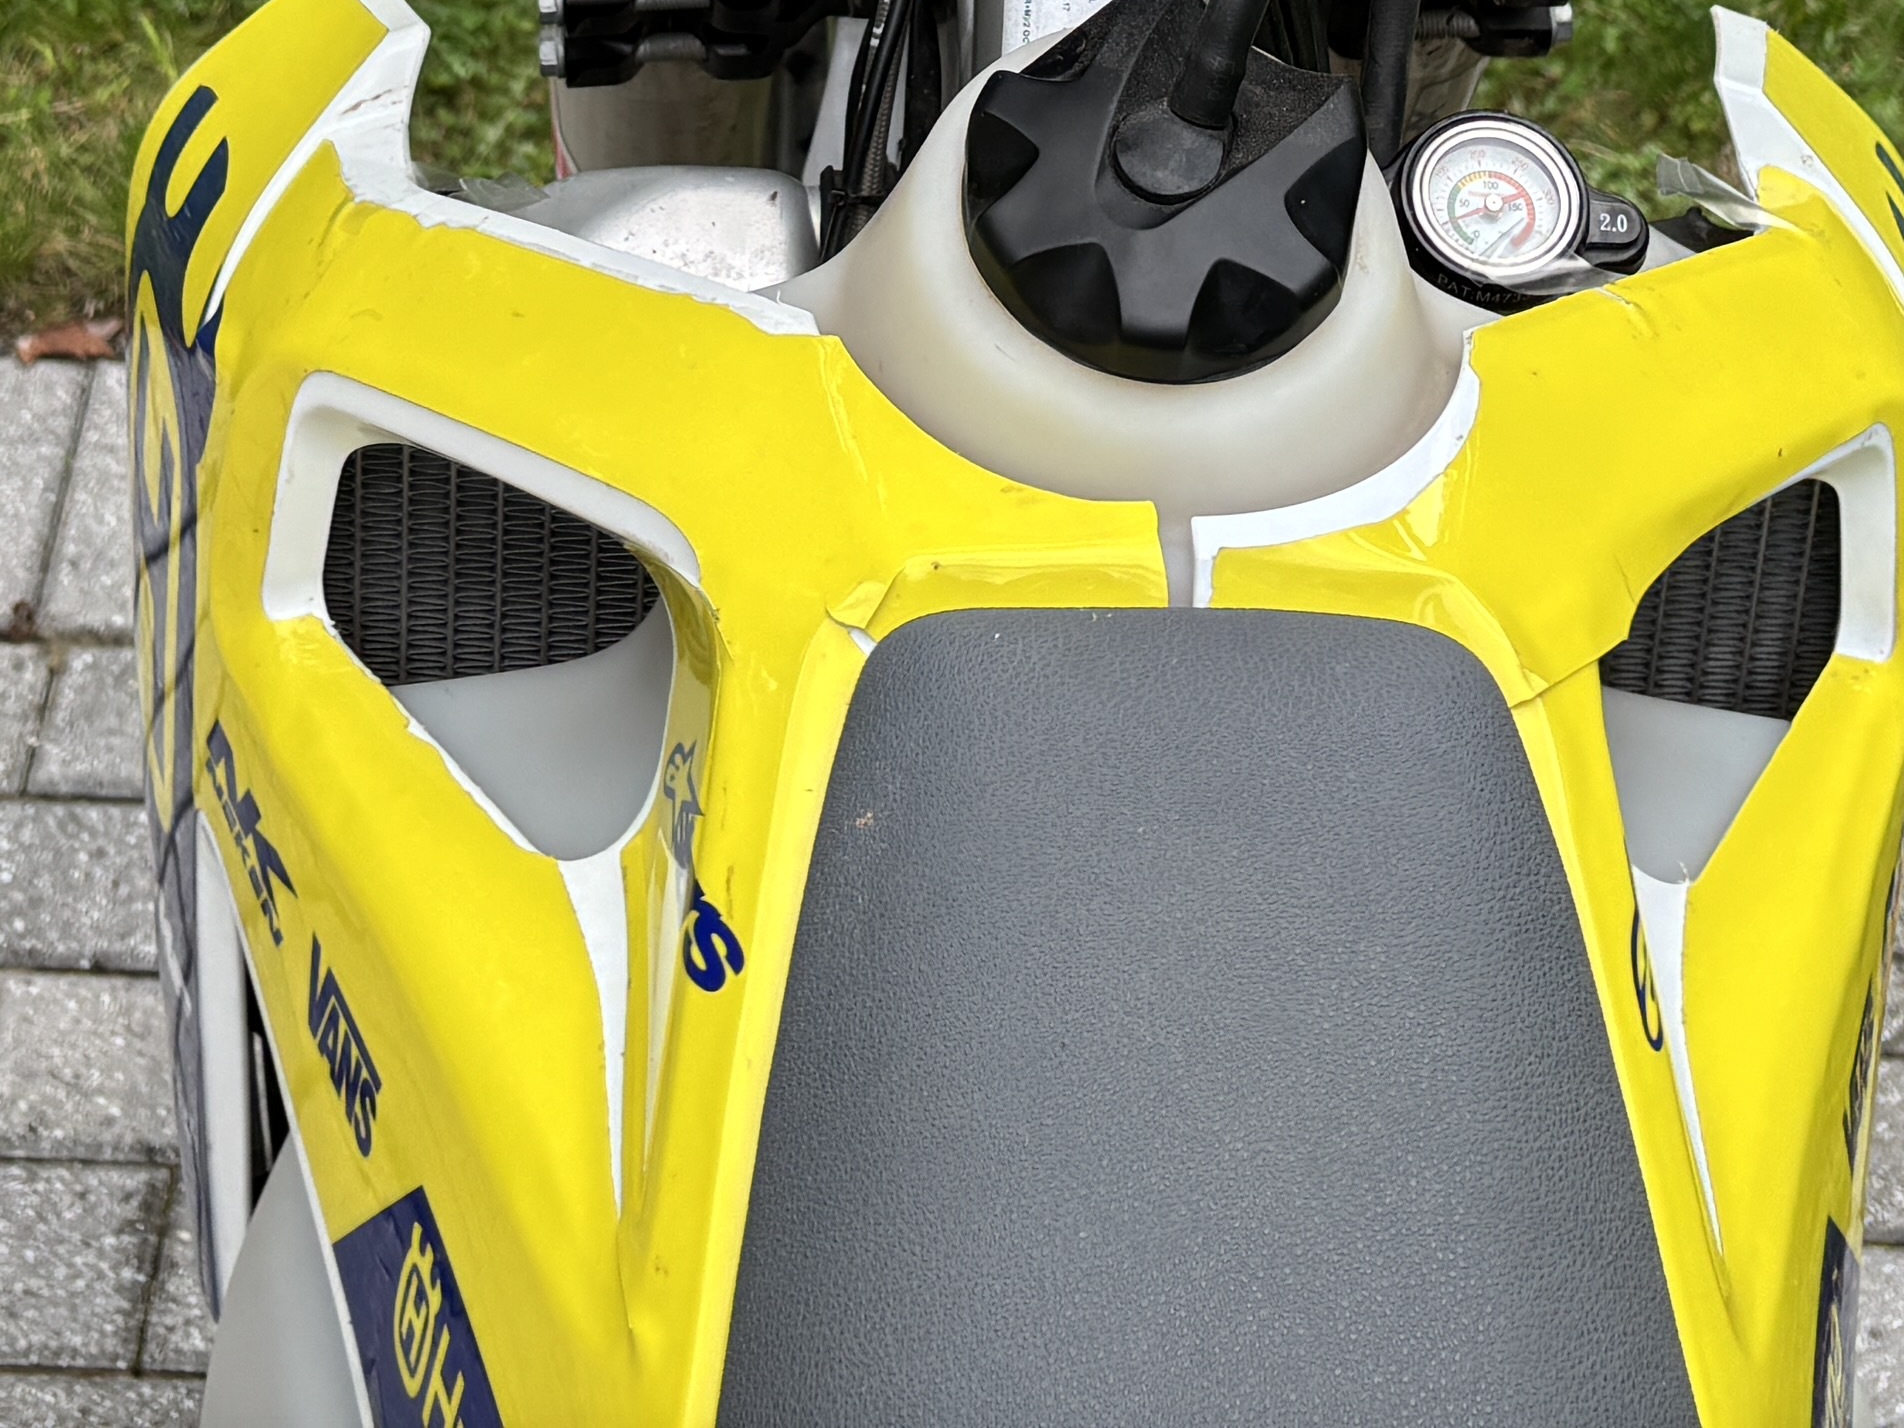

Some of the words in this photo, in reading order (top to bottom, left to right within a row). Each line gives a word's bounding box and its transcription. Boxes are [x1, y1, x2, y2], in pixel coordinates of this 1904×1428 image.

[1483, 180, 1499, 190] 100
[1599, 213, 1628, 233] 2.0
[308, 931, 383, 1159] VANS
